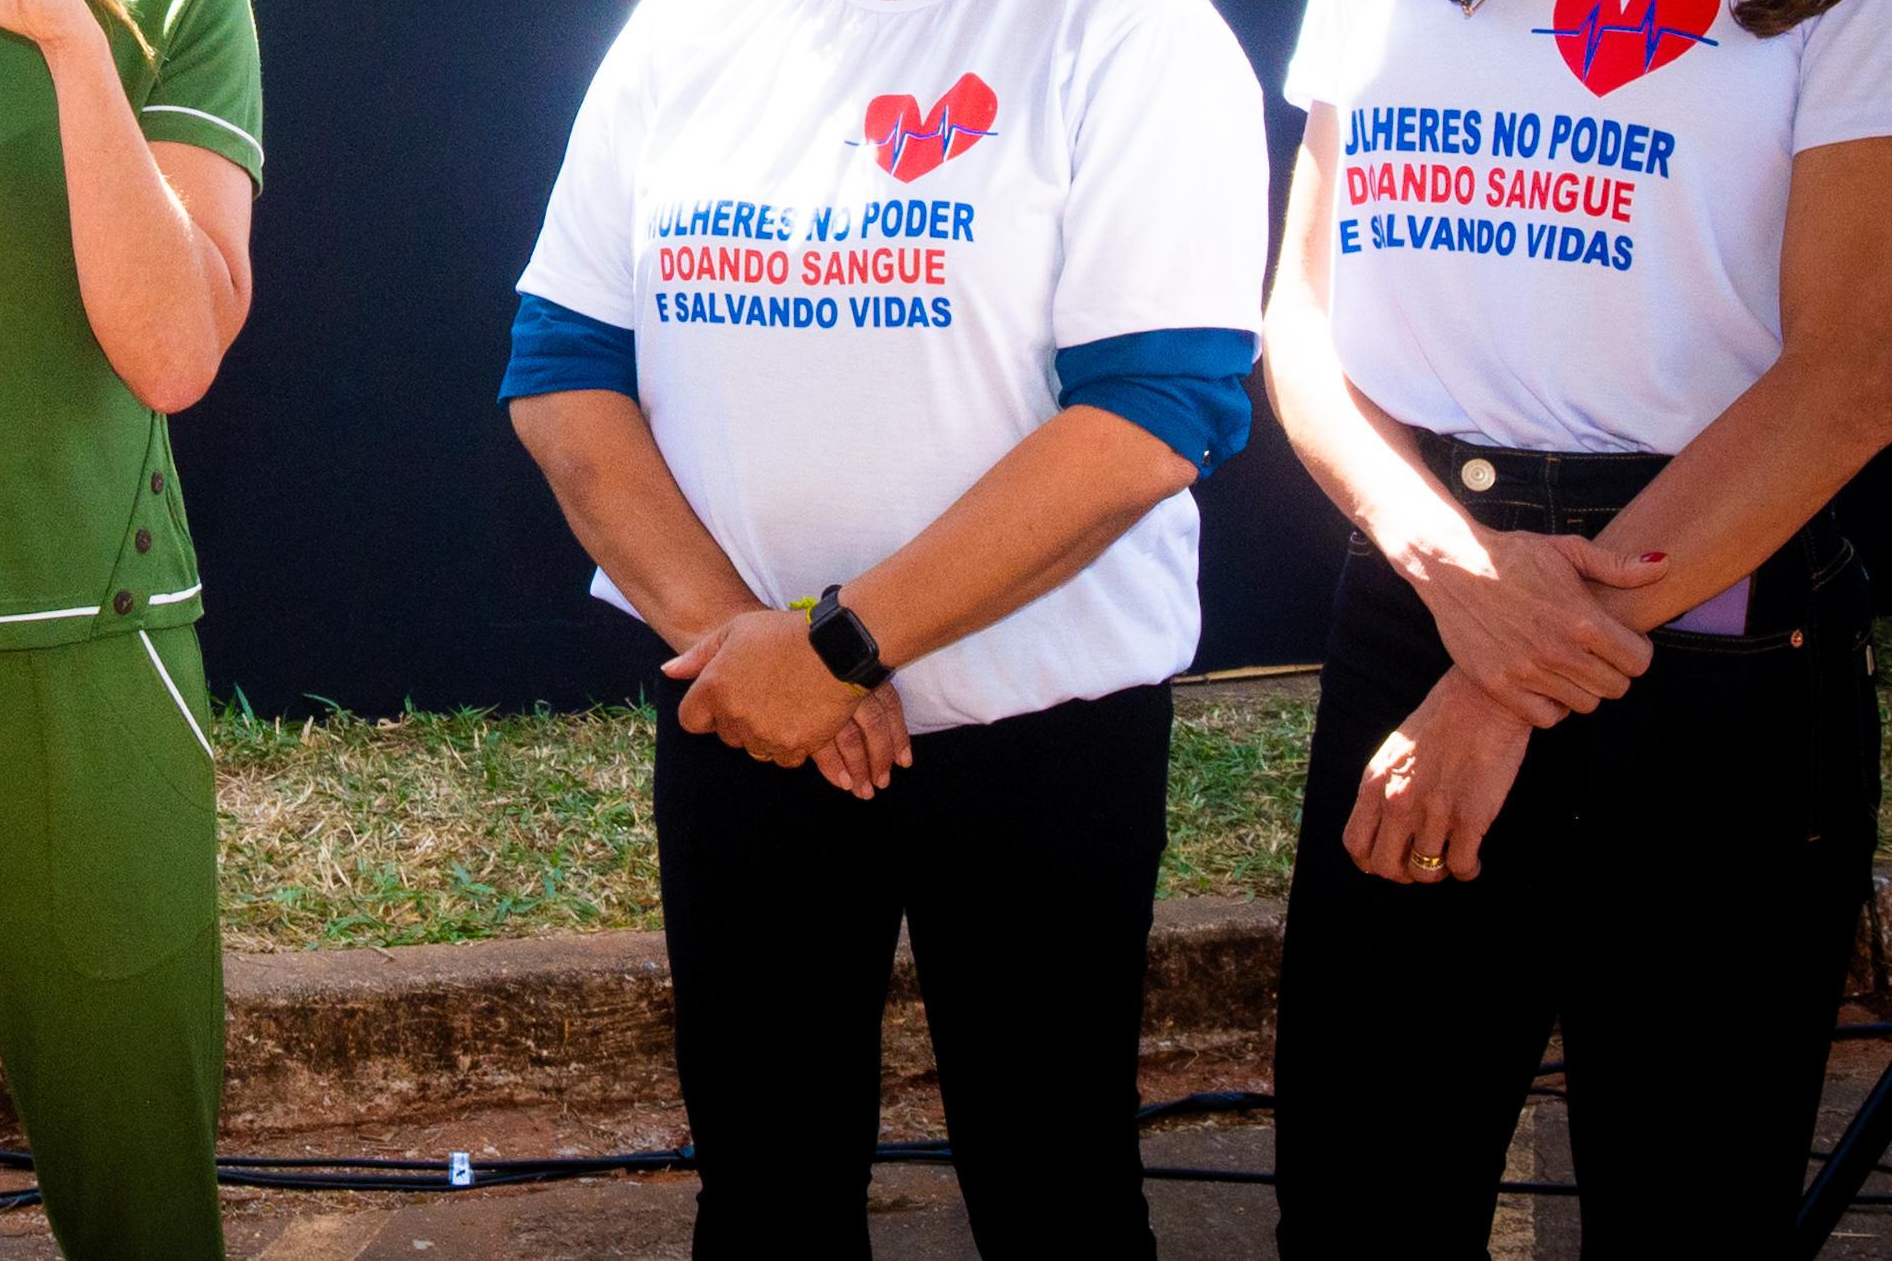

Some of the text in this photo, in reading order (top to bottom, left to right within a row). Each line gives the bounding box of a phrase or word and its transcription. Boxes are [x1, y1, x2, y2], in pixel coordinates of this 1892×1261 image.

[1344, 107, 1676, 179] ULHERES NO PODER
[1485, 168, 1636, 224] SANGUE
[806, 205, 852, 242] NO
[861, 199, 975, 242] PODER
[659, 246, 946, 286] DOANDO SANGUE
[1339, 219, 1362, 255] E
[1526, 223, 1634, 272] VIDAS
[655, 292, 953, 329] E SALVANDO VIDAS
